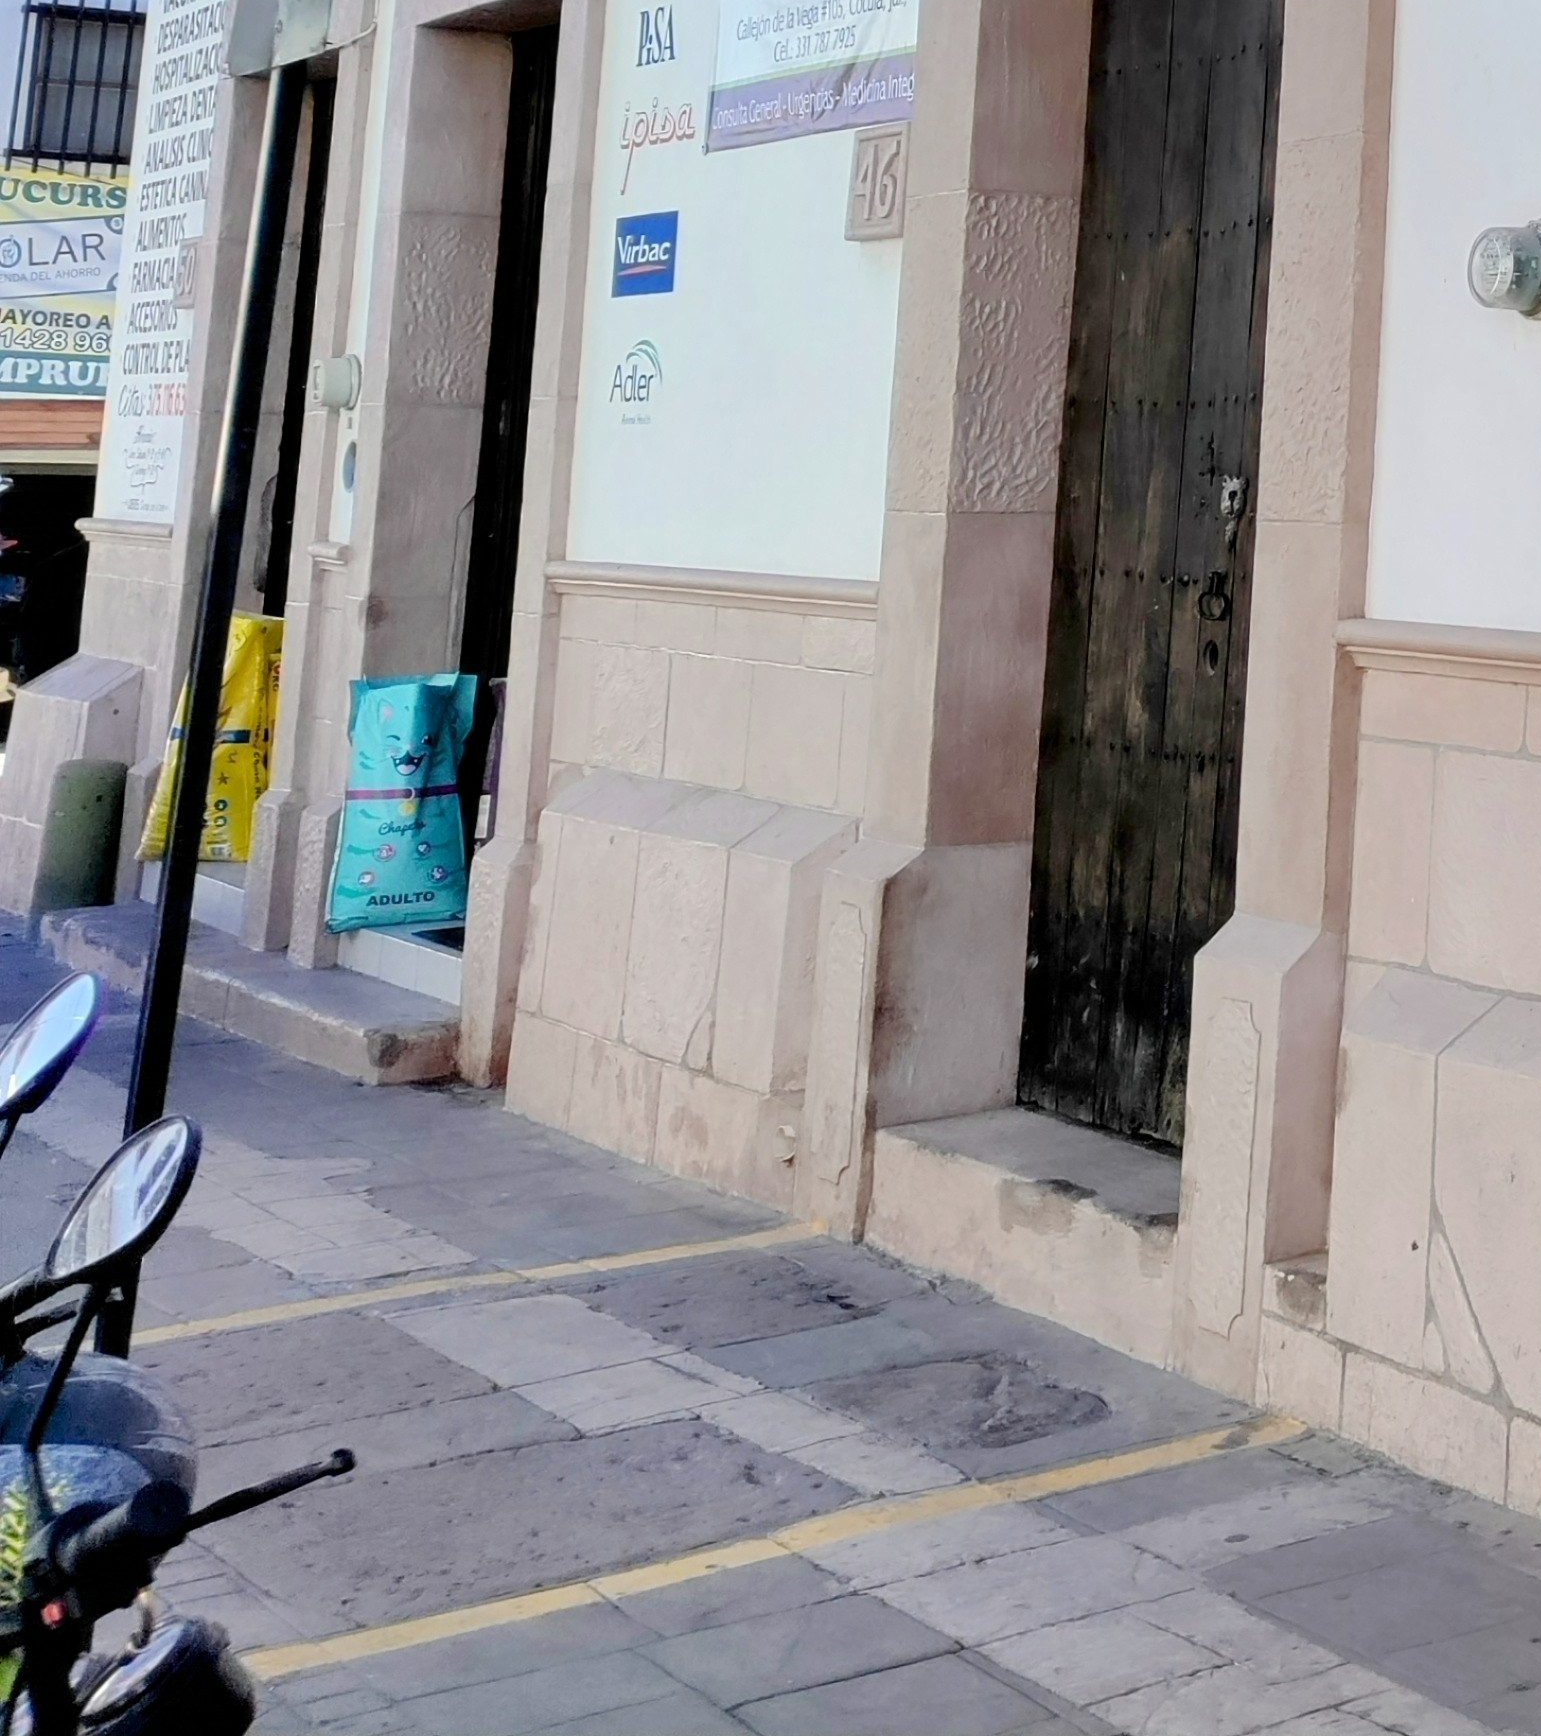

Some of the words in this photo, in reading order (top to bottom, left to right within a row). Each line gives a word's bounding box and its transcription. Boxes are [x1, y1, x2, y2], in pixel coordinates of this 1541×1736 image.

[772, 12, 785, 33] de
[795, 35, 810, 58] 331
[814, 30, 831, 55] 787
[833, 25, 856, 50] 7925
[149, 93, 187, 134] LIMPIEZA
[712, 102, 748, 130] Consulta
[749, 96, 782, 124] General
[788, 88, 833, 119] Urgencias
[844, 77, 886, 108] Medicina
[144, 133, 186, 175] ANALISIS
[140, 176, 177, 212] ESTETICA
[136, 213, 187, 252] ALIMENTOS
[617, 233, 670, 265] Virbac
[30, 271, 52, 283] DEL
[55, 267, 101, 280] AHORRO
[131, 256, 176, 294] FARMACIA
[0, 307, 91, 329] AYOREO
[127, 298, 178, 335] ACCESORIOS
[73, 331, 112, 354] 96
[123, 341, 159, 375] CONTROL
[161, 340, 174, 375] DE
[609, 364, 654, 403] Adler
[366, 891, 435, 906] ADULTO
